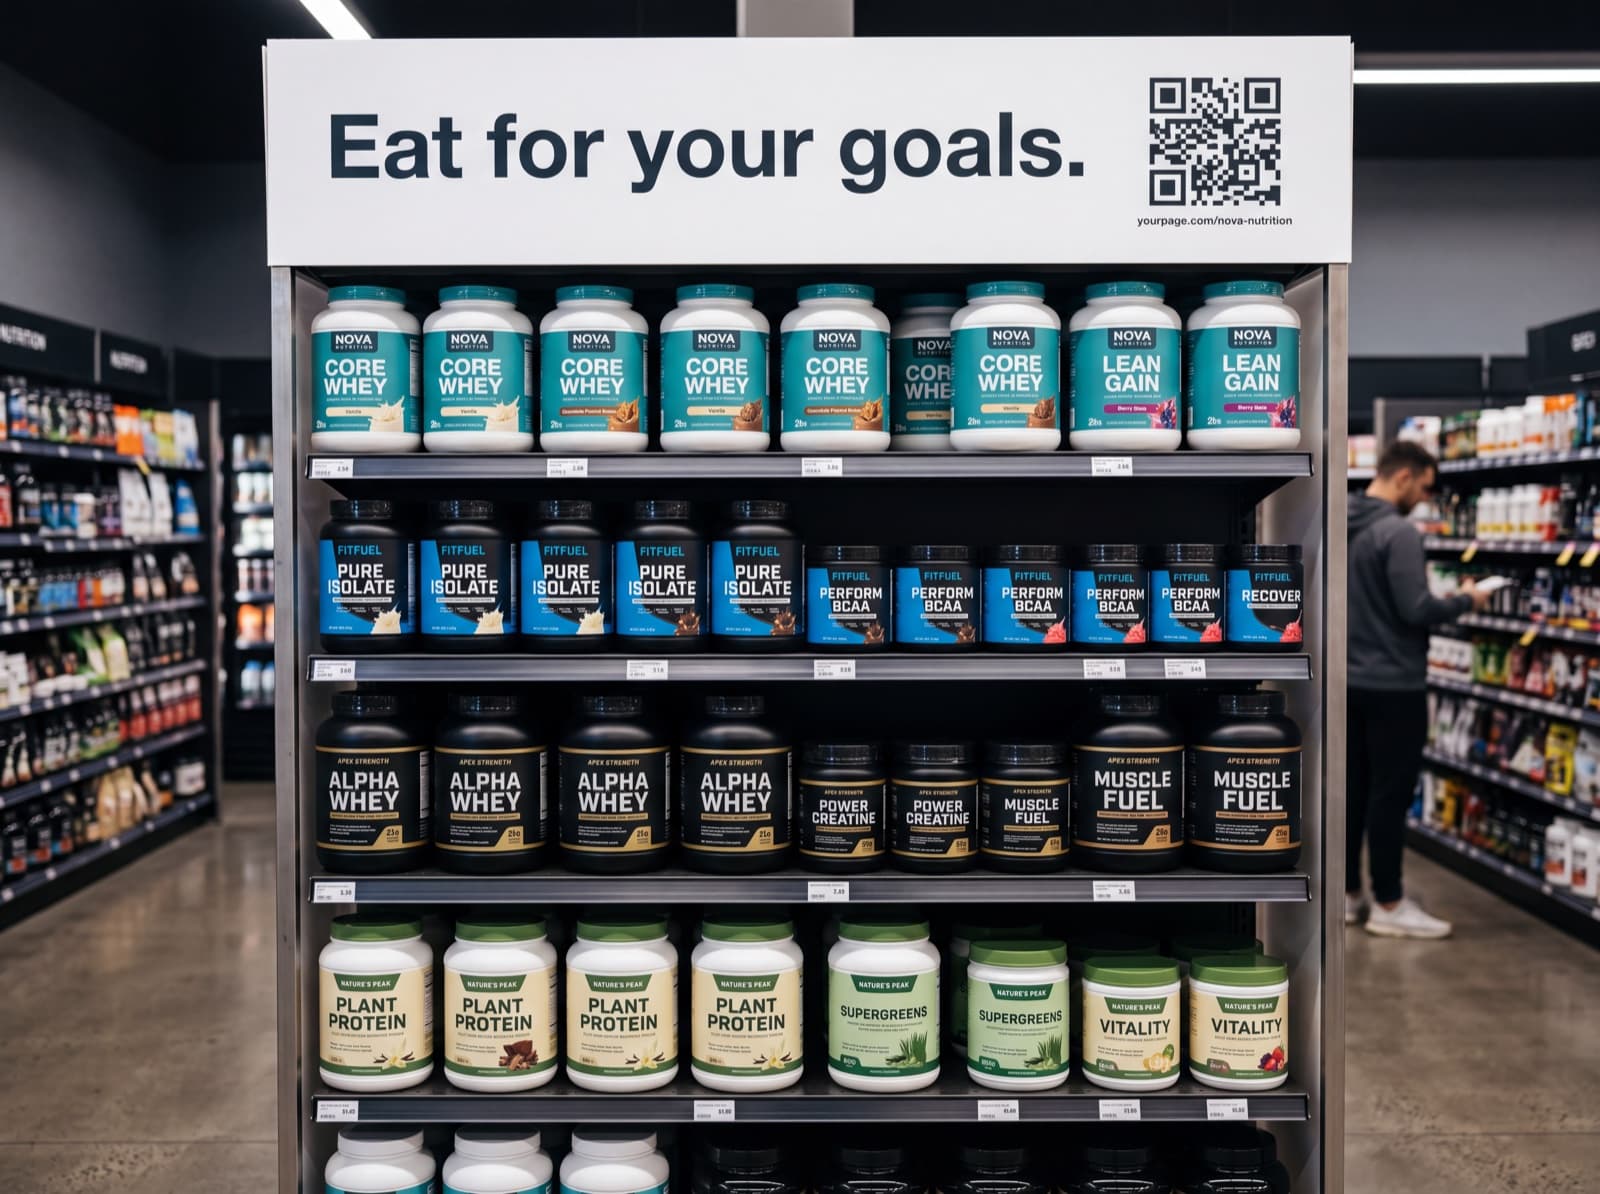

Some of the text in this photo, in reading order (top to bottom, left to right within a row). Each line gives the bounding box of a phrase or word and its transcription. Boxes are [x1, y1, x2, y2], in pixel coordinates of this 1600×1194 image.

[330, 112, 1085, 193] Eat for your goals.
[1137, 216, 1292, 227] yourpage.com/nova-nutrition
[336, 334, 372, 344] NOVA
[451, 334, 488, 344] NOVA
[573, 334, 609, 344] NOVA
[698, 334, 735, 344] NOVA
[819, 333, 856, 343] NOVA
[993, 330, 1030, 341] NOVA
[1114, 331, 1151, 340] NOVA
[1234, 330, 1271, 340] NOVA
[325, 359, 386, 376] CORE
[441, 359, 501, 375] CORE
[561, 359, 623, 376] CORE
[686, 358, 748, 375] CORE
[806, 358, 868, 375] CORE
[980, 355, 1041, 372] CORE
[1103, 355, 1161, 372] LEAN
[1223, 355, 1281, 372] LEAN
[906, 365, 950, 381] COR
[324, 378, 387, 394] WHEY
[439, 378, 503, 394] WHEY
[560, 378, 624, 394] WHEY
[685, 377, 749, 394] WHEY
[804, 377, 870, 393] WHEY
[978, 375, 1043, 391] WHEY
[1105, 374, 1159, 392] GAIN
[1225, 374, 1279, 391] GAIN
[905, 383, 951, 399] WHE
[338, 545, 382, 555] FITFUEL
[441, 546, 485, 555] FITFUEL
[544, 546, 588, 556] FITFUEL
[640, 547, 684, 556] FITFUEL
[735, 546, 780, 557] FITFUEL
[338, 564, 384, 578] PURE
[442, 564, 487, 578] PURE
[544, 564, 589, 579] PURE
[640, 565, 686, 579] PURE
[735, 565, 781, 579] PURE
[832, 572, 870, 581] FITFUEL
[924, 571, 962, 581] FITFUEL
[1015, 572, 1052, 581] FITFUEL
[1099, 574, 1134, 582] FITFUEL
[1174, 574, 1210, 582] FITFUEL
[1255, 573, 1291, 581] FITFUEL
[328, 580, 395, 594] ISOLATE
[431, 580, 498, 594] ISOLATE
[533, 581, 600, 595] ISOLATE
[629, 581, 696, 595] ISOLATE
[724, 581, 791, 595] ISOLATE
[820, 587, 882, 599] PERFORM
[912, 587, 973, 599] PERFORM
[1002, 587, 1063, 599] PERFORM
[1162, 588, 1220, 599] PERFORM
[1088, 589, 1144, 600] PERFORM
[1242, 590, 1301, 601] RECOVER
[833, 600, 870, 612] BCAA
[925, 600, 962, 612] BCAA
[1015, 600, 1052, 612] BCAA
[1100, 601, 1134, 612] BCAA
[1174, 600, 1210, 612] BCAA
[330, 772, 399, 789] ALPHA
[450, 772, 521, 790] ALPHA
[578, 772, 648, 790] ALPHA
[701, 772, 771, 790] ALPHA
[1095, 770, 1171, 788] MUSCLE
[1214, 771, 1290, 788] MUSCLE
[330, 791, 399, 811] WHEY
[450, 792, 521, 811] WHEY
[578, 792, 648, 812] WHEY
[701, 792, 771, 812] WHEY
[819, 800, 868, 812] POWER
[914, 800, 963, 813] POWER
[1004, 798, 1059, 811] MUSCLE
[1103, 790, 1164, 810] FUEL
[1223, 791, 1283, 810] FUEL
[812, 812, 876, 825] CREATINE
[906, 812, 969, 825] CREATINE
[1015, 812, 1049, 824] FUEL
[341, 980, 372, 988] NATURE'S
[336, 997, 397, 1013] PLANT
[463, 998, 523, 1014] PLANT
[589, 998, 649, 1014] PLANT
[716, 998, 777, 1014] PLANT
[840, 1005, 927, 1021] SUPERGREENS
[979, 1010, 1062, 1025] SUPERGREENS
[329, 1013, 406, 1030] PROTEIN
[456, 1015, 532, 1031] PROTEIN
[581, 1014, 658, 1031] PROTEIN
[708, 1014, 785, 1031] PROTEIN
[1100, 1019, 1170, 1035] VITALITY
[1212, 1018, 1282, 1034] VITALITY
